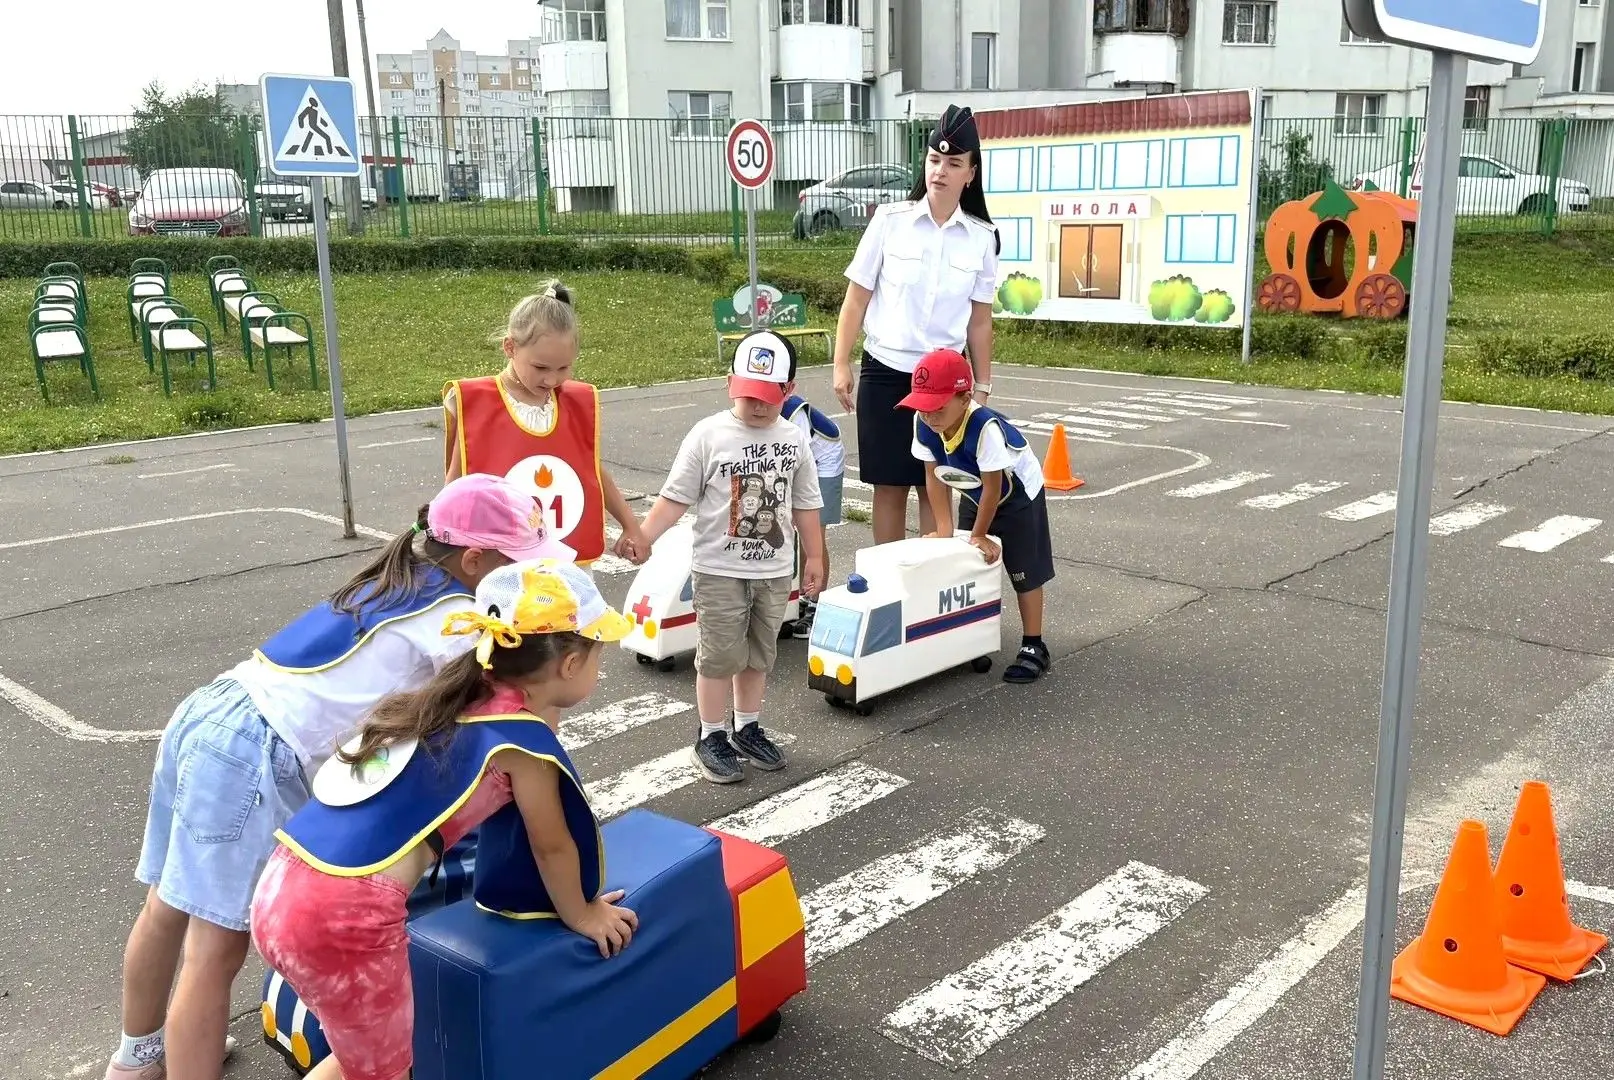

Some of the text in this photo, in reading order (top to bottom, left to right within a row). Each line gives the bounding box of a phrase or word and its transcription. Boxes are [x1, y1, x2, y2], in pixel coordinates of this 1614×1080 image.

[738, 140, 764, 169] 50
[1050, 203, 1138, 216] ШКОЛА
[742, 442, 798, 459] THE BEST
[780, 456, 797, 473] PET
[531, 495, 563, 529] 1
[724, 539, 765, 551] AT YOUR
[938, 581, 976, 615] МЧС
